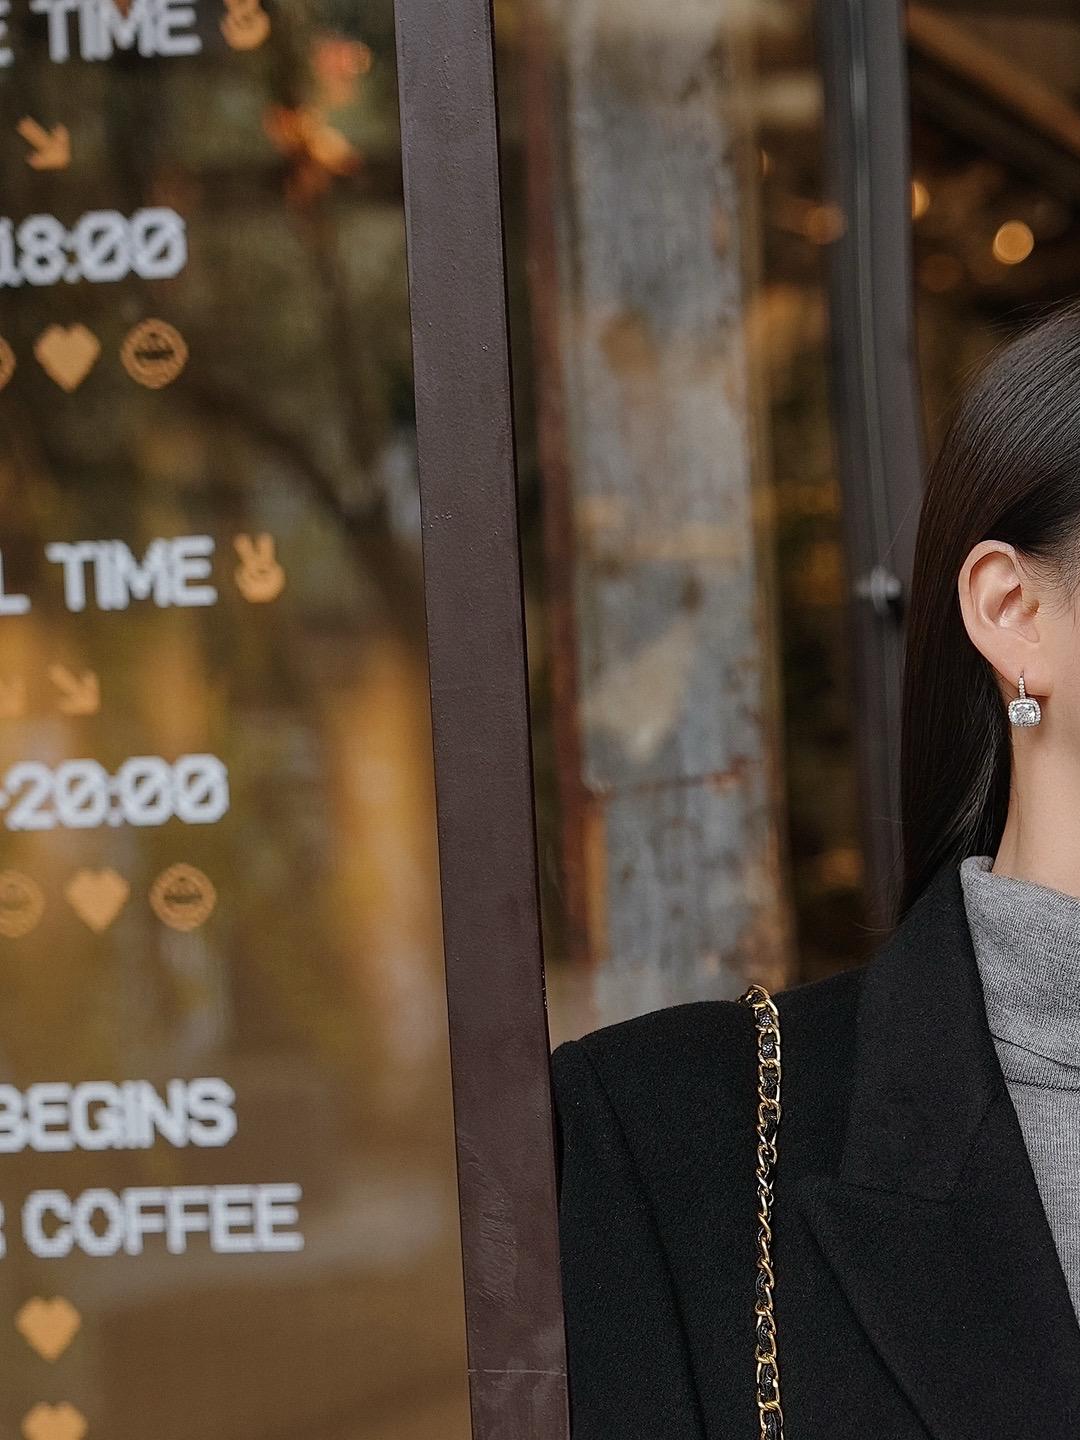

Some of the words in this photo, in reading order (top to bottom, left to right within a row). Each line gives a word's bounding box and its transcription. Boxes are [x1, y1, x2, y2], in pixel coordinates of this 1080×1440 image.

[29, 0, 202, 63] TIME
[44, 534, 218, 613] TIME
[0, 1077, 238, 1153] BEGINS
[21, 1182, 304, 1259] COFFEE
